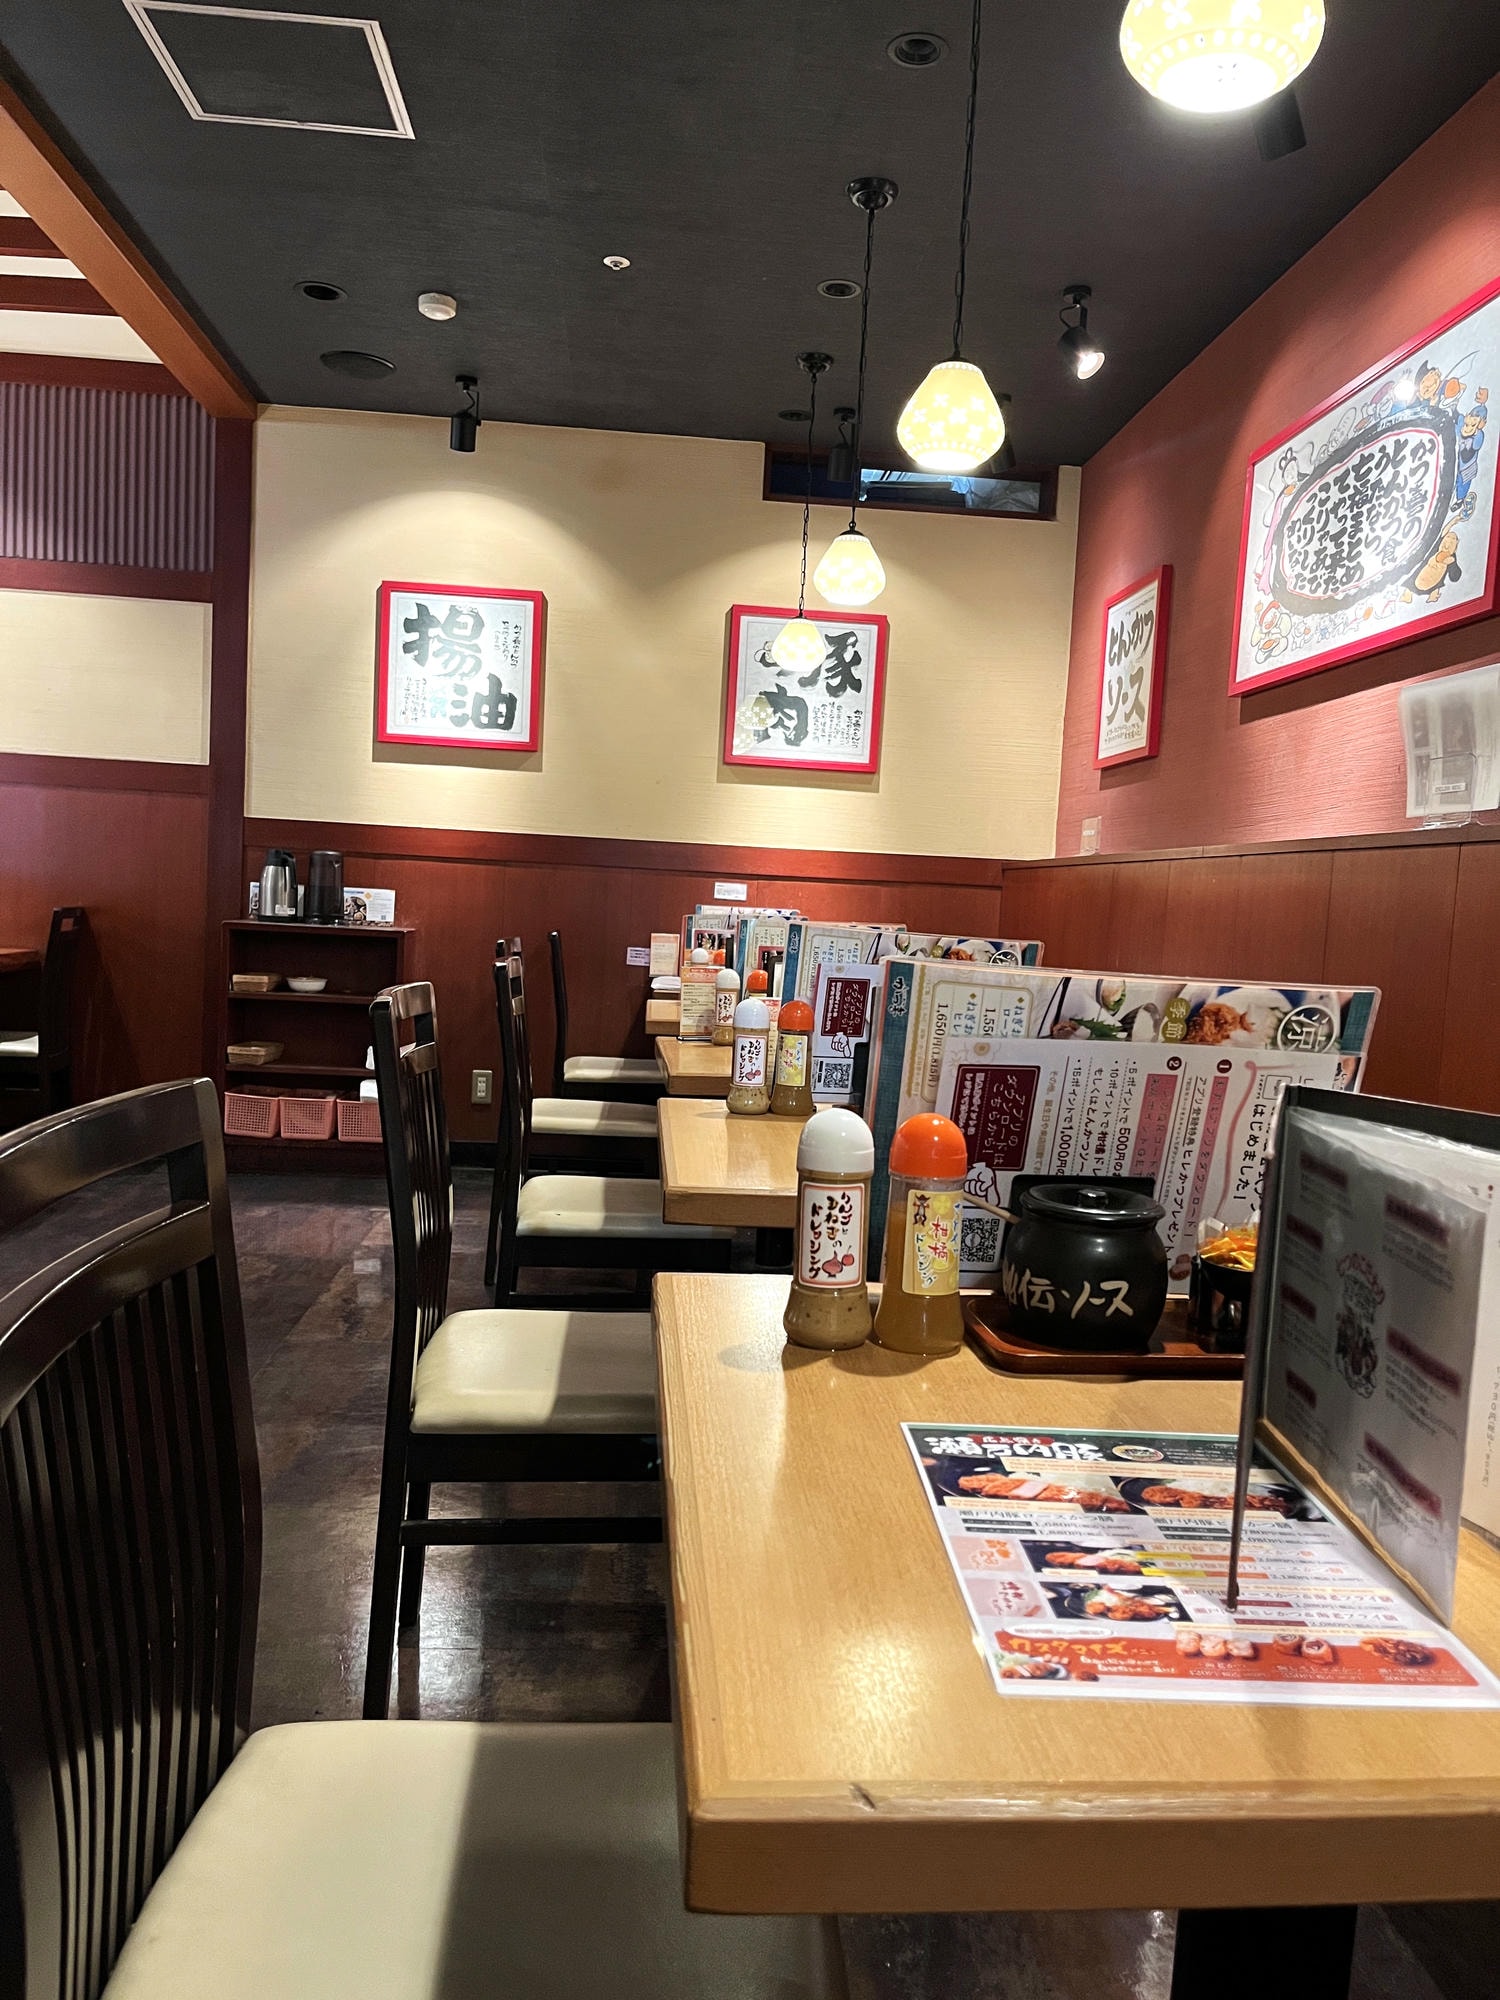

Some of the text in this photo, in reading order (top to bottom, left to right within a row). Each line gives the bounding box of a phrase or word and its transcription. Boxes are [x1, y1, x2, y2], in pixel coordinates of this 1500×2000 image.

[1376, 438, 1409, 567] とんかつ食
[1402, 438, 1437, 540] かつ喜の
[1307, 481, 1332, 595] こりゃあび
[1323, 466, 1351, 595] てやって来た
[1108, 609, 1154, 667] とんかつ
[1164, 1001, 1188, 1040] 季節
[1286, 1013, 1330, 1052] 涼
[981, 1082, 1006, 1155] こちらから!
[991, 1074, 1019, 1166] ダウンロードは
[1007, 1092, 1027, 1147] アプリの
[1075, 1067, 1104, 1178] もしくはとんかつソー
[1233, 1103, 1268, 1202] はじめました!
[808, 1202, 823, 1280] ドレッシング
[839, 1191, 853, 1236] りんごと
[928, 1216, 949, 1262] 柑橘
[924, 1436, 1107, 1462] 瀬戸内豚
[1008, 1637, 1128, 1655] カスタマイズ
